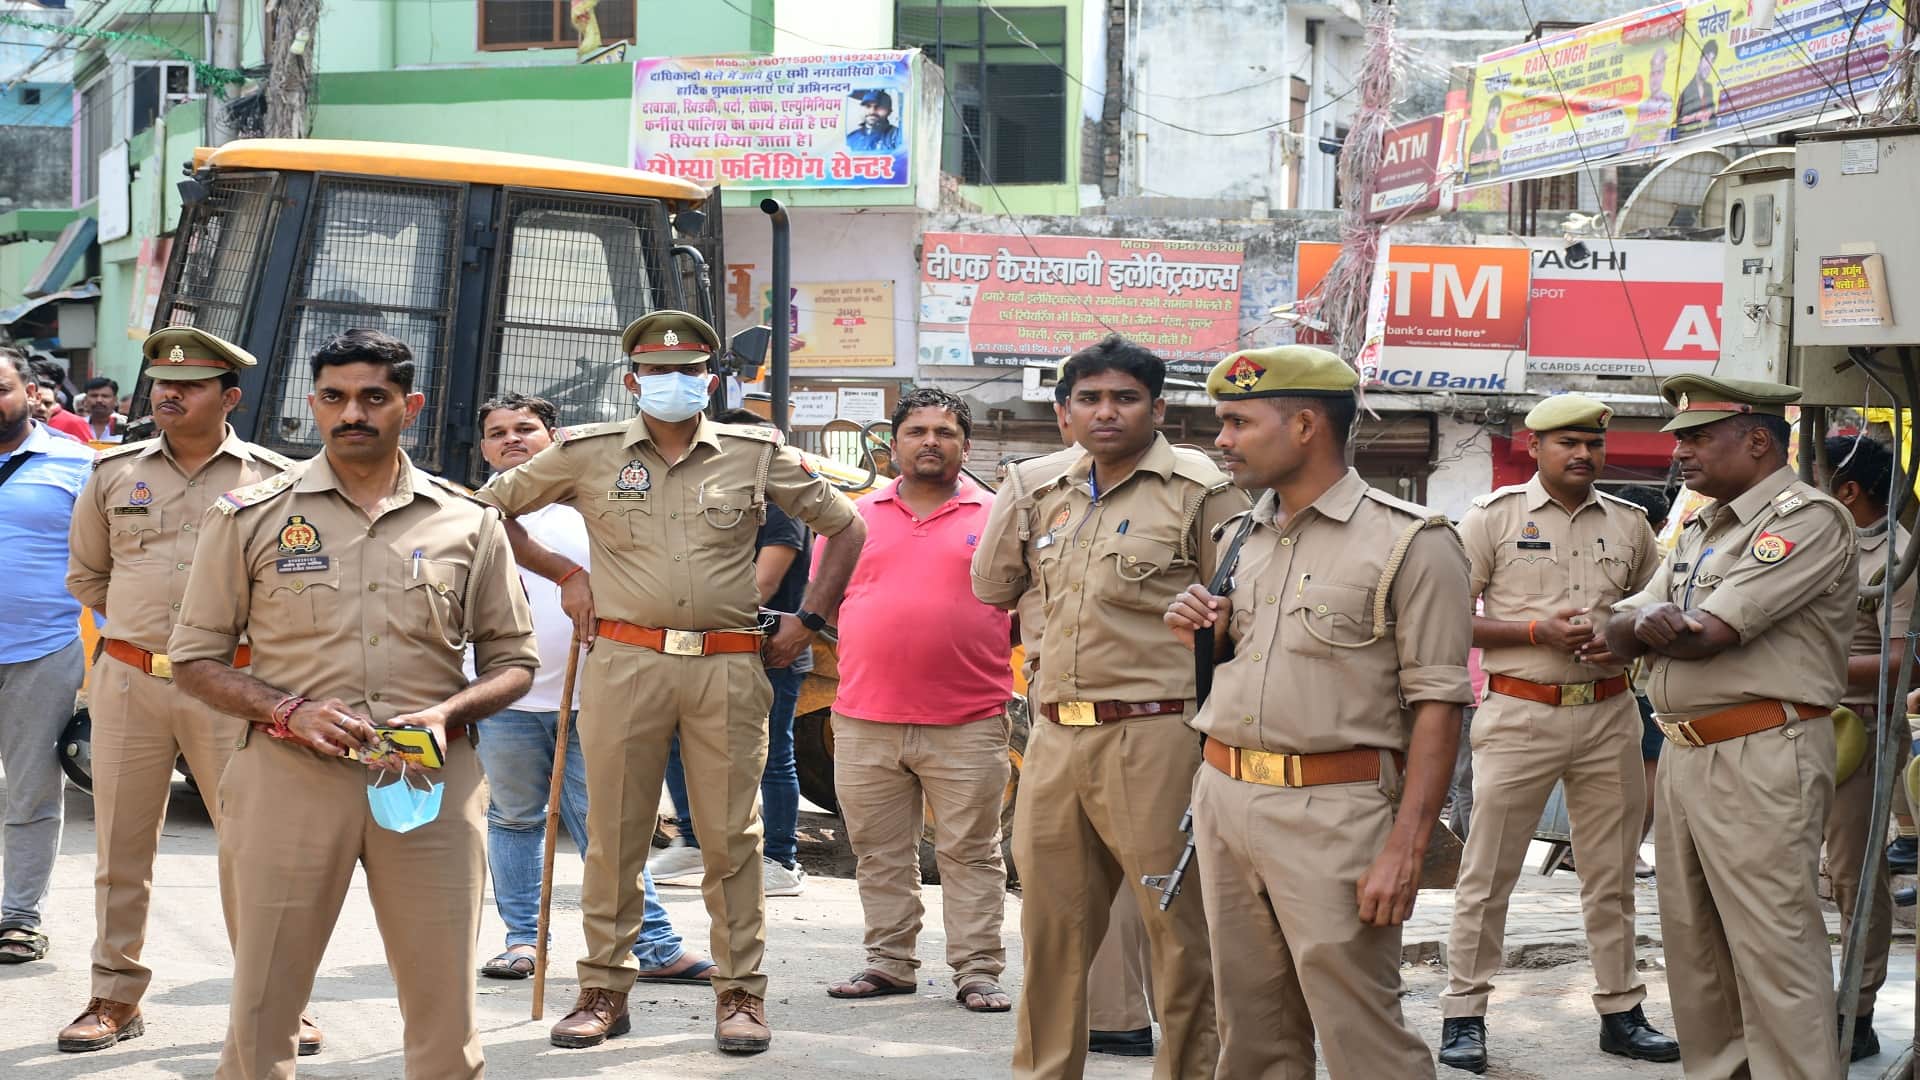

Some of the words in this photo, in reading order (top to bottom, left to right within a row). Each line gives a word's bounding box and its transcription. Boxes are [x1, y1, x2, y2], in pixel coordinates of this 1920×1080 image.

[1552, 42, 1589, 68] SINGH
[1382, 132, 1429, 168] ATM
[647, 152, 714, 179] सौम्या
[831, 151, 893, 178] सेन्टर
[926, 244, 992, 280] दीपक
[1531, 250, 1626, 271] TACHI
[1389, 262, 1503, 320] TM
[1386, 325, 1424, 337] bank's
[1426, 327, 1451, 337] card
[1663, 304, 1722, 351] A
[1380, 369, 1421, 387] ICI
[1427, 372, 1506, 390] Bank
[1540, 361, 1582, 372] CARDS
[1585, 362, 1646, 373] ACCEPTED
